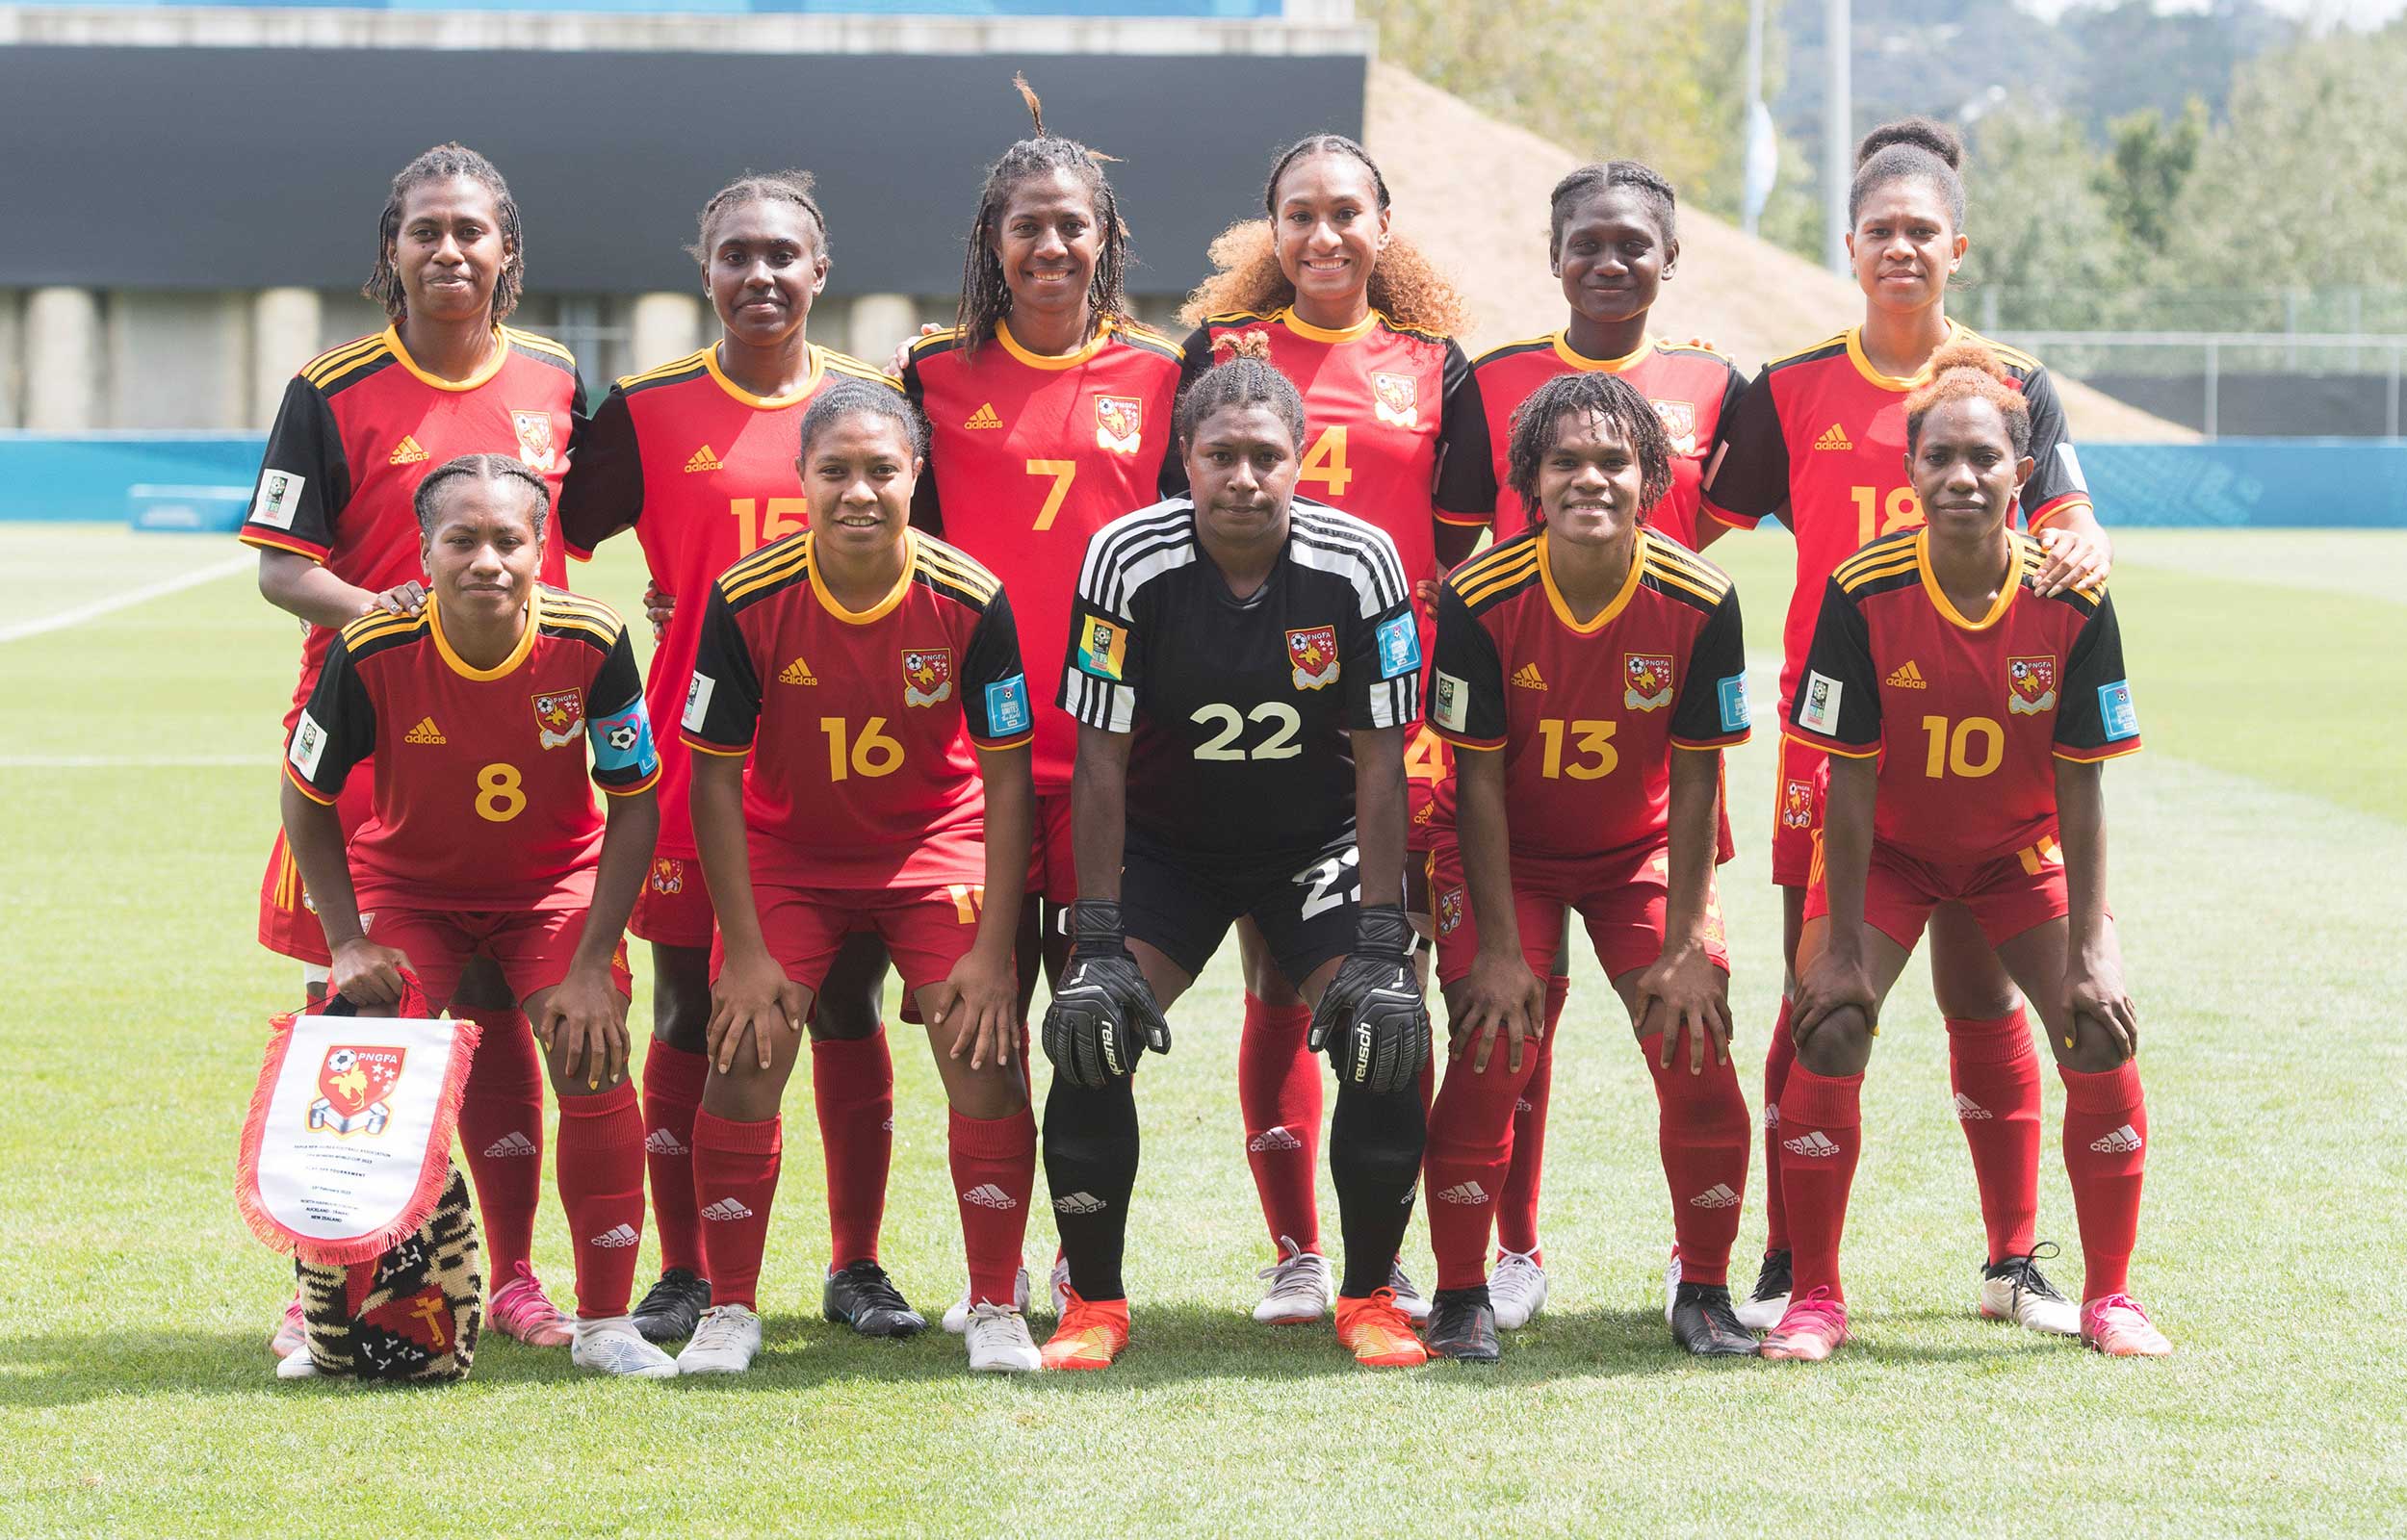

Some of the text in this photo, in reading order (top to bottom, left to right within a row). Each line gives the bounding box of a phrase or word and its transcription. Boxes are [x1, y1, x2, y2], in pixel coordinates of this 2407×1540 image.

[964, 420, 1003, 429] adidas
[1815, 440, 1853, 450] adidas
[389, 449, 429, 465] adidas
[1299, 425, 1352, 496] 4
[685, 461, 724, 473] adidas
[1026, 459, 1076, 531] 7
[1851, 486, 1928, 550] 18
[731, 498, 809, 559] 15
[778, 674, 817, 686] adidas
[1511, 677, 1548, 692] adidas
[1886, 676, 1927, 690] adidas
[1189, 701, 1303, 761] 22
[404, 733, 447, 745] adidas
[820, 716, 905, 783] 16
[1539, 719, 1618, 781] 13
[1922, 715, 2005, 779] 10
[1404, 725, 1447, 788] 4
[475, 762, 528, 822] 8
[1101, 1020, 1125, 1076] reusch
[1355, 1022, 1372, 1083] reusch
[357, 1052, 399, 1064] PNGFA
[484, 1145, 536, 1158] adidas
[1250, 1139, 1302, 1152] adidas
[1784, 1140, 1840, 1157] adidas
[2090, 1139, 2142, 1154] adidas
[963, 1193, 1017, 1210] adidas
[1437, 1192, 1488, 1204] adidas
[1691, 1194, 1741, 1209] adidas
[701, 1209, 753, 1221] adidas
[591, 1234, 639, 1248] adidas
